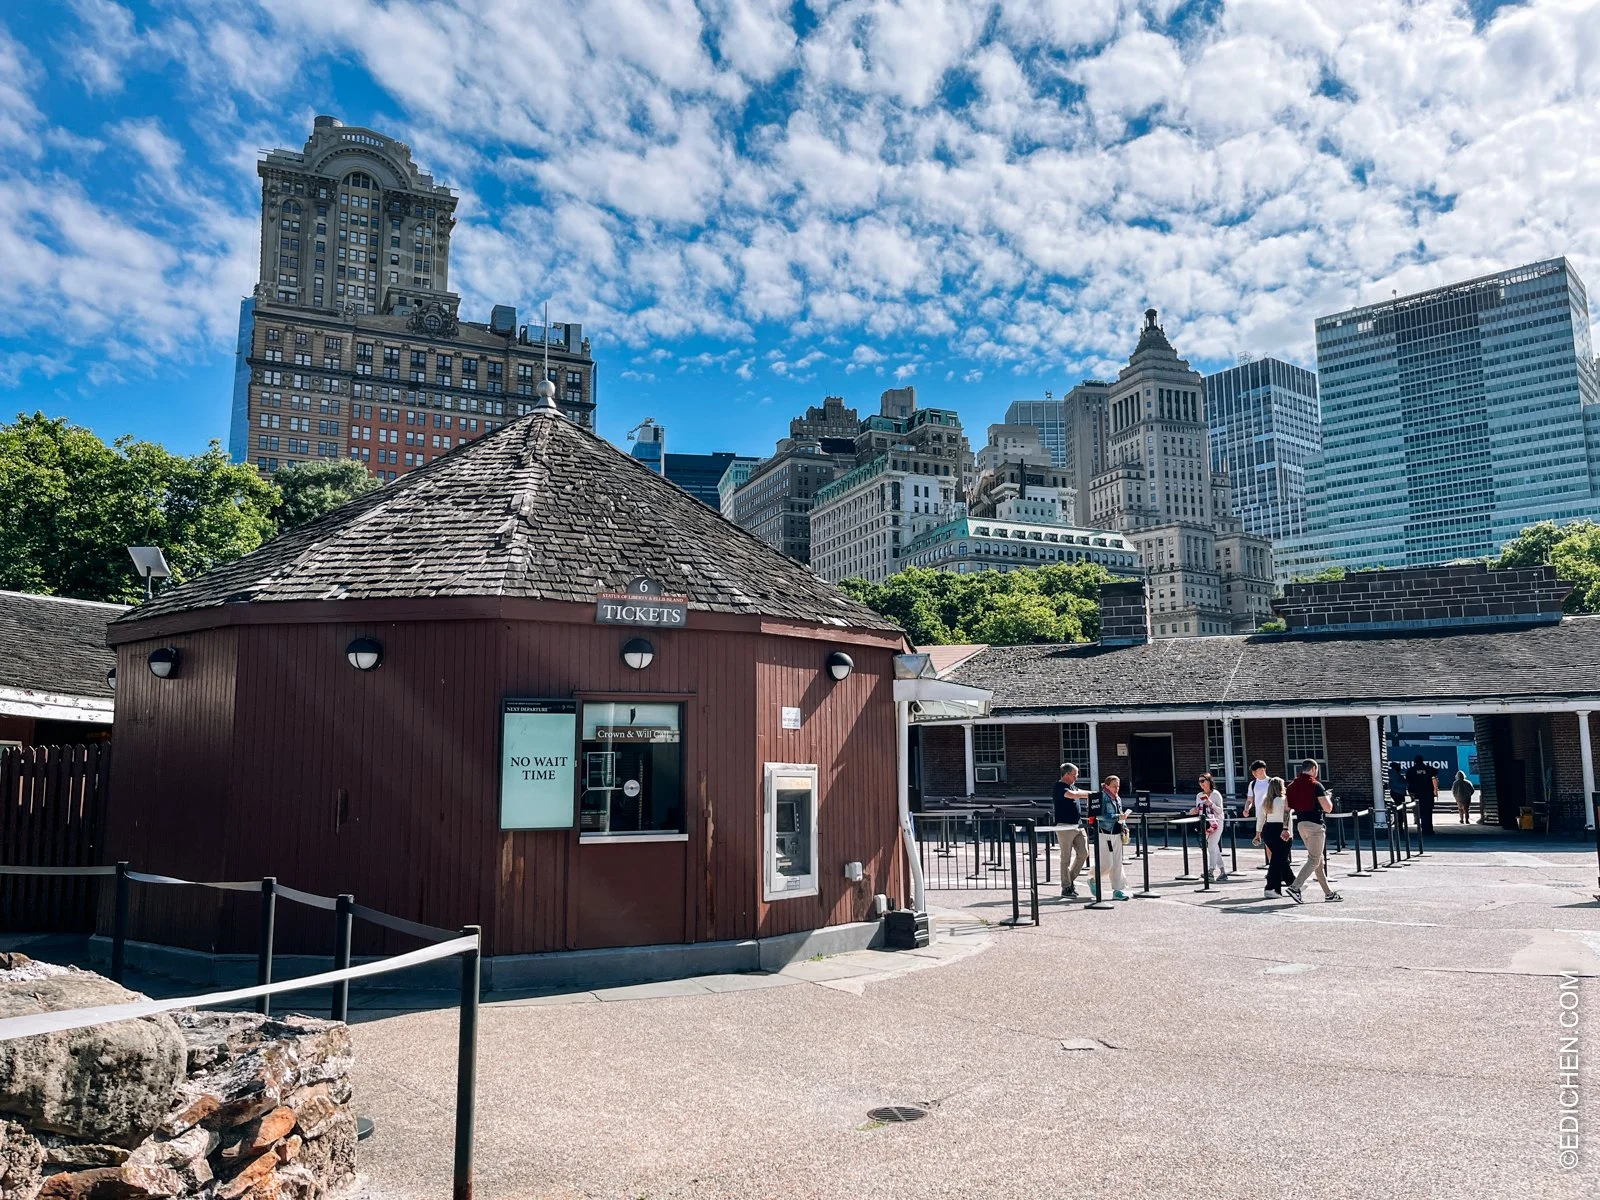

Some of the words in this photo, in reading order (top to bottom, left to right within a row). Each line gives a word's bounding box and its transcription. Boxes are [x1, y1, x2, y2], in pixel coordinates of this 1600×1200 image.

[639, 579, 649, 593] 6
[602, 604, 681, 623] TICKETS
[597, 730, 625, 739] Crown
[627, 730, 634, 738] &
[636, 729, 652, 739] Will
[510, 756, 531, 767] NO
[534, 756, 568, 767] WAIT
[521, 770, 556, 780] TIME
